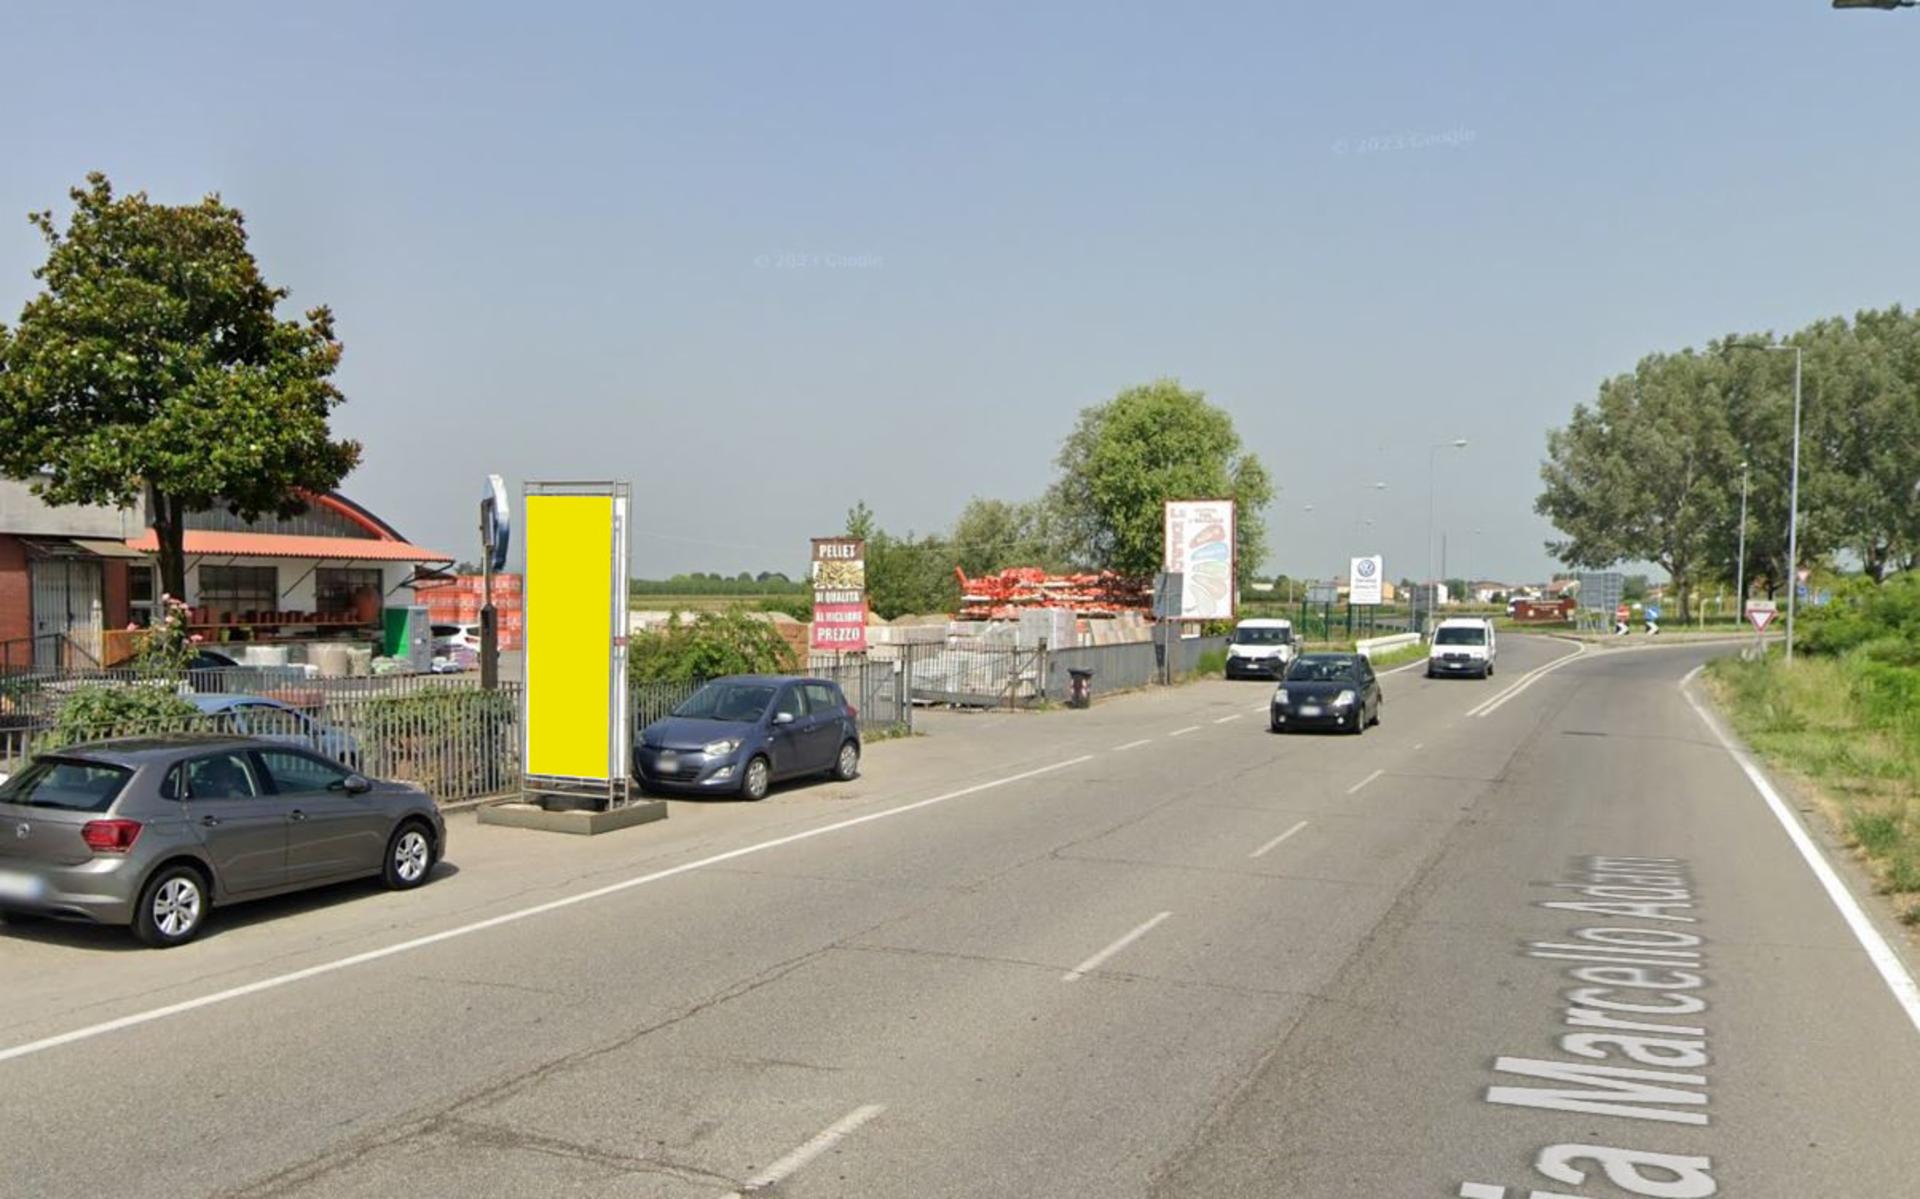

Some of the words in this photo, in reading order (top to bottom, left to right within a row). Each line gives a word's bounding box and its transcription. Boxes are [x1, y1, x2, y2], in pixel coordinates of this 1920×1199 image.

[819, 544, 856, 558] PELLET
[817, 627, 860, 641] PREZZO
[1487, 927, 1709, 1125] Marcello
